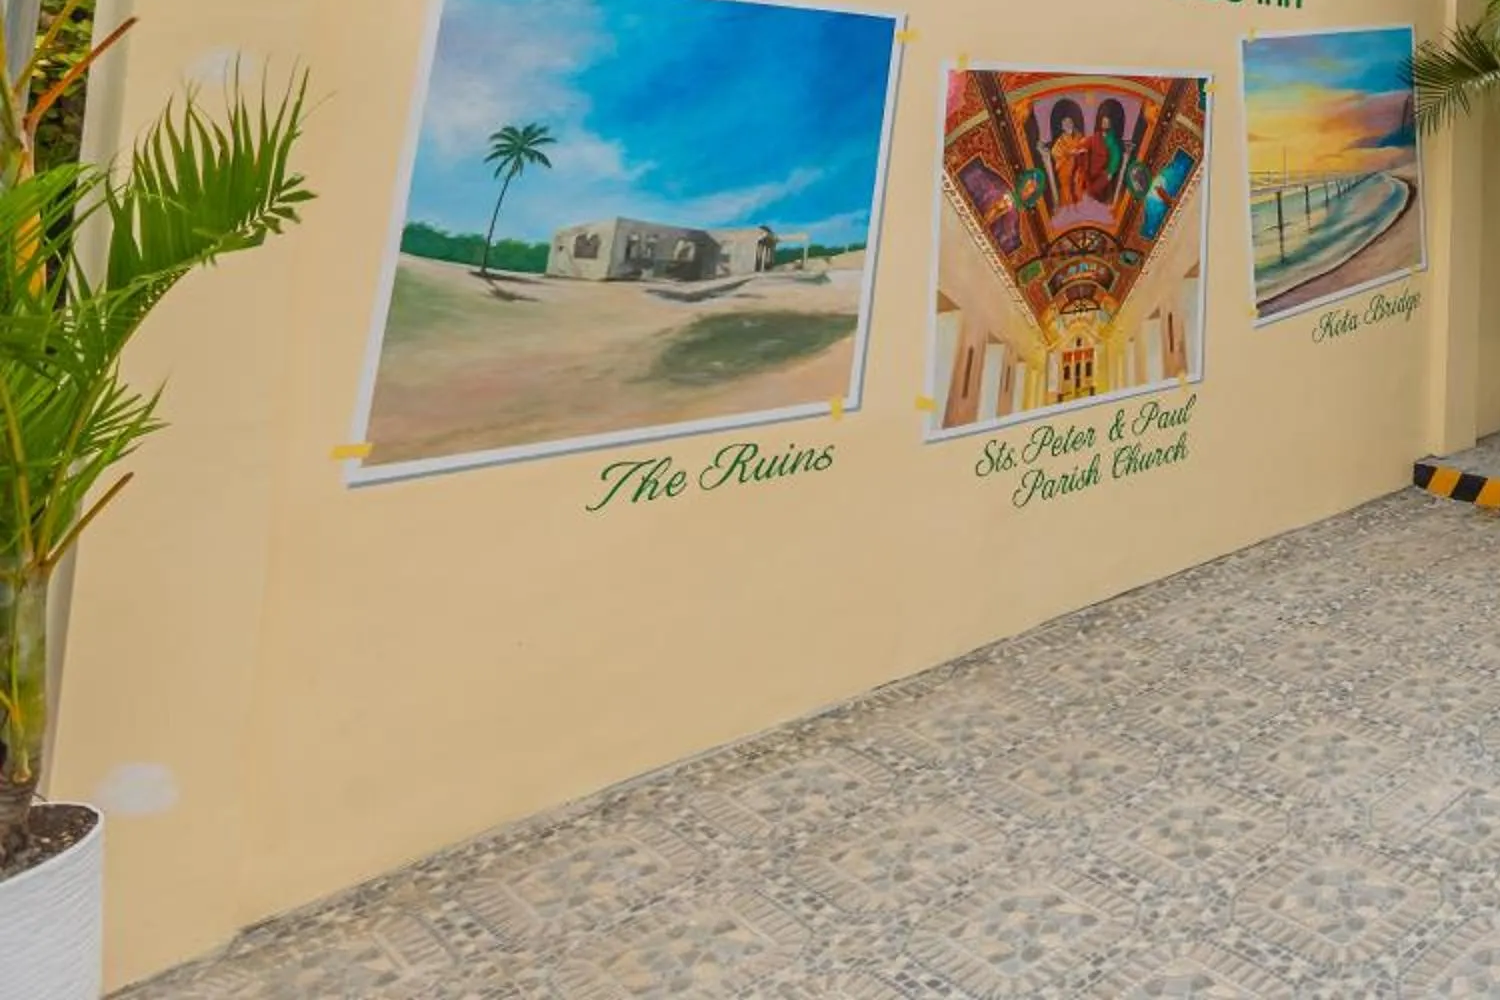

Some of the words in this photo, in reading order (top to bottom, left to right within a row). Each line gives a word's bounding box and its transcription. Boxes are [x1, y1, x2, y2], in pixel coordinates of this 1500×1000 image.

[1364, 287, 1421, 322] Bridge
[975, 439, 1018, 477] Sts.
[1022, 425, 1097, 464] Peter
[1109, 408, 1125, 441] &
[1132, 393, 1197, 436] Paul
[1012, 453, 1101, 508] Parish
[1112, 431, 1190, 479] Church
[585, 456, 687, 511] The
[699, 443, 835, 490] Ruins
